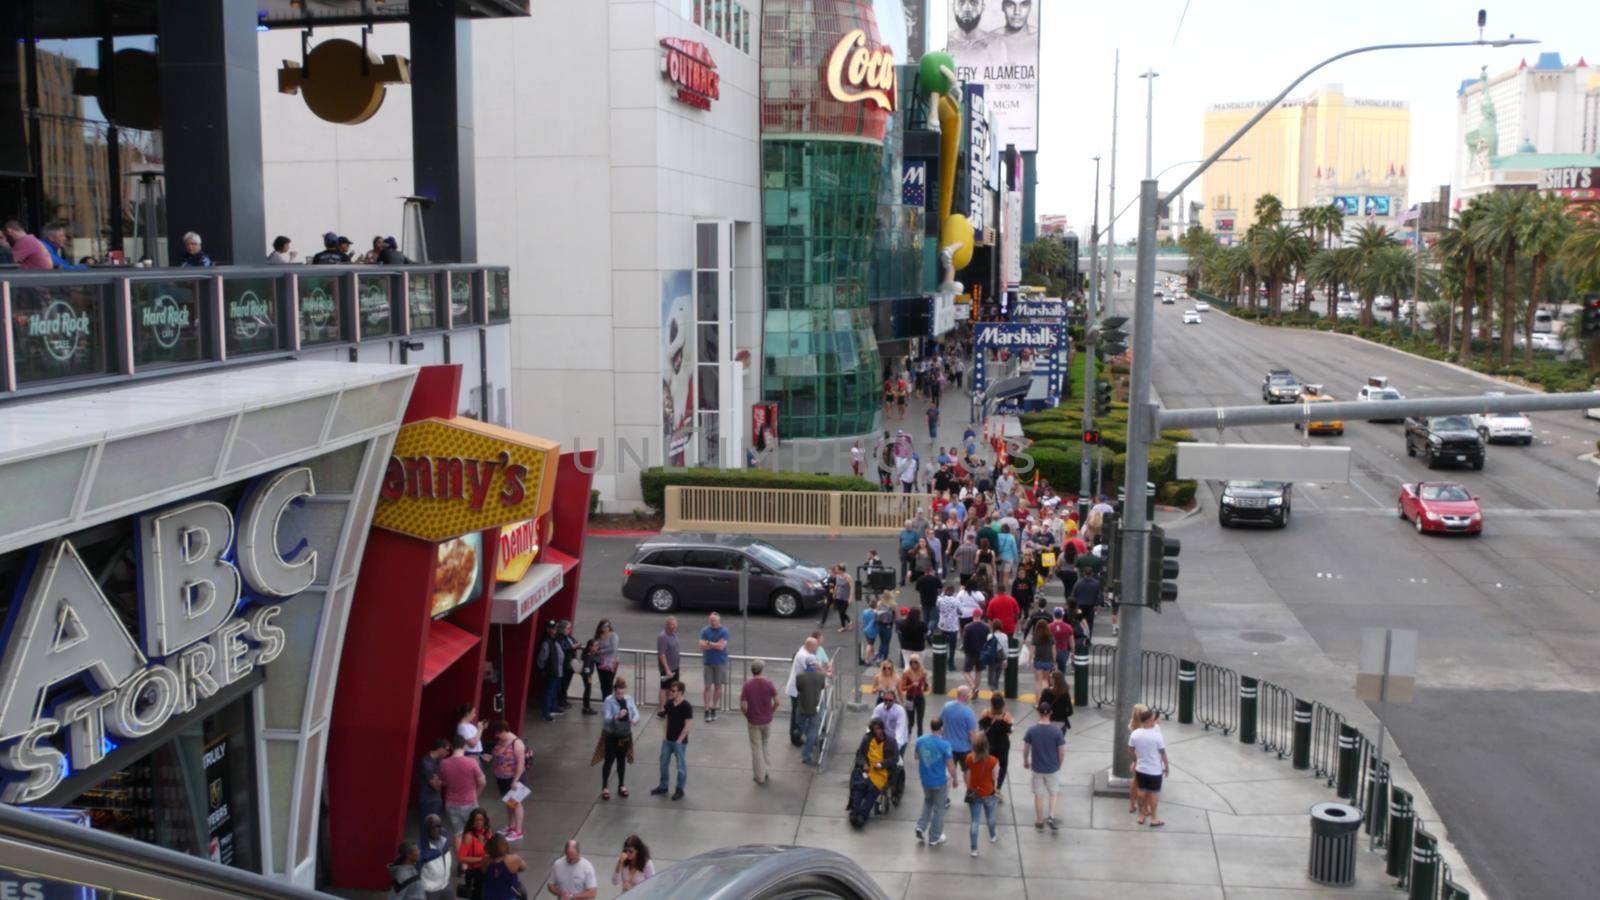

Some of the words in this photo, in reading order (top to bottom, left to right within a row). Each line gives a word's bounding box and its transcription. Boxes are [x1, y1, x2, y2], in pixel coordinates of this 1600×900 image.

[668, 48, 719, 100] OUTBACK
[984, 66, 1035, 80] ALAMEDA
[993, 100, 1019, 109] MGM
[970, 93, 984, 231] SKECHERS
[142, 305, 167, 326] Hard
[167, 304, 189, 327] Rock
[230, 300, 250, 318] Hard
[250, 299, 268, 318] Rock
[1013, 303, 1066, 316] Marshalls
[29, 312, 60, 336] Hard
[62, 311, 89, 337] Rock
[977, 326, 1057, 345] Marshalls
[0, 467, 317, 741] ABC
[4, 604, 286, 804] STORES
[202, 742, 227, 769] TRULY
